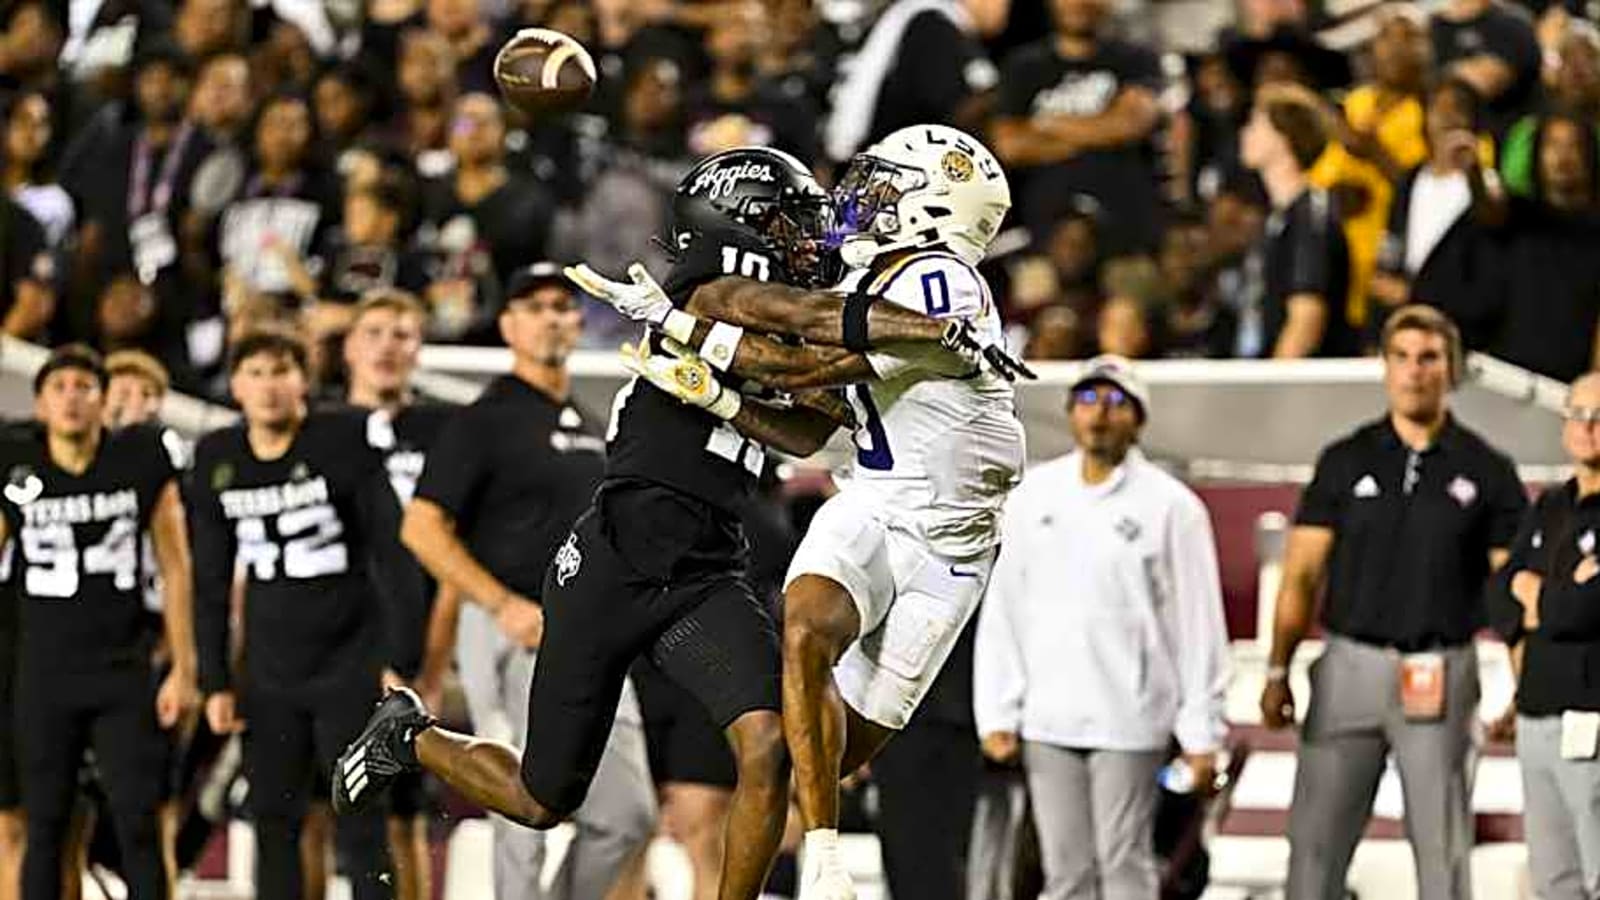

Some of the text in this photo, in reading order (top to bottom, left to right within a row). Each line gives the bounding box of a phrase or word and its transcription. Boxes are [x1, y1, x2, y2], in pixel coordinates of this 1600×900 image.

[689, 160, 775, 200] Aggies
[921, 270, 951, 316] 0
[21, 521, 138, 598] 94
[235, 505, 348, 580] 42
